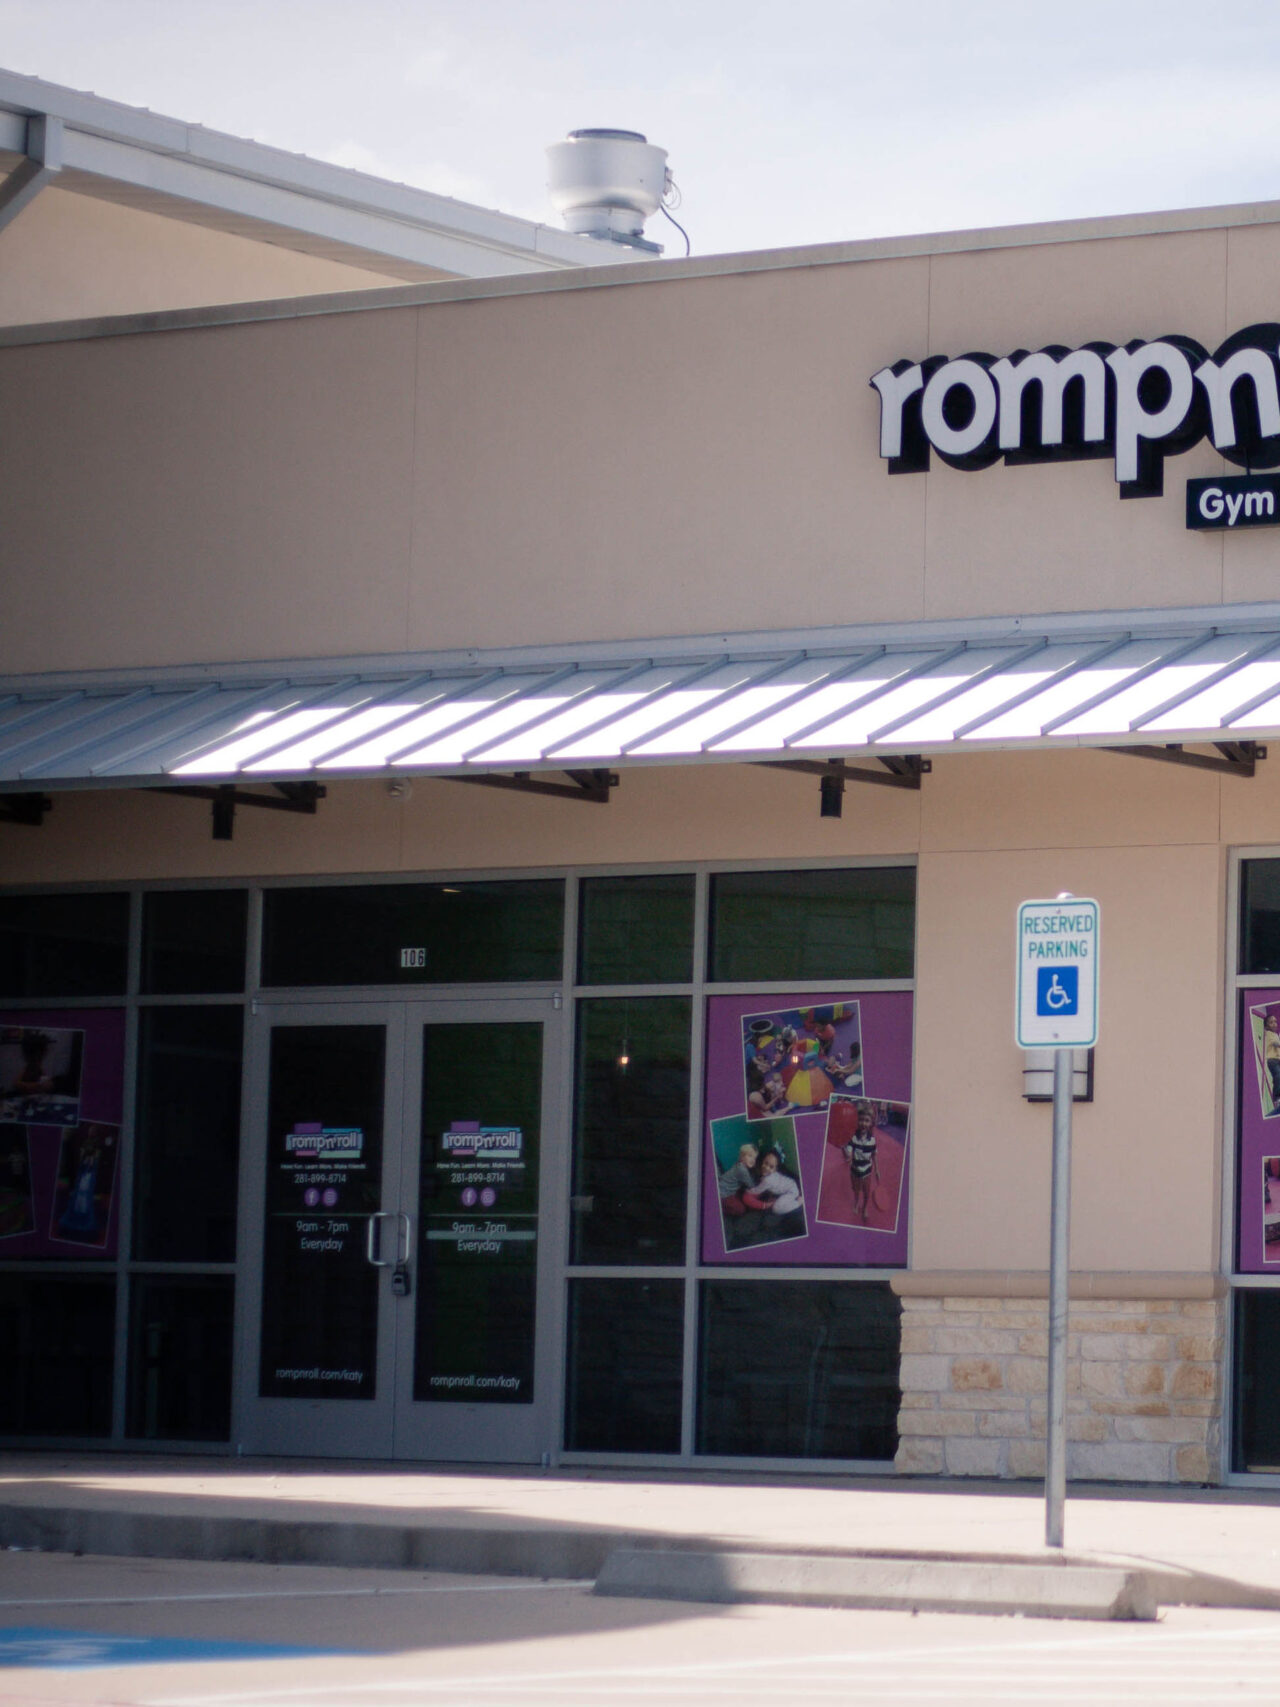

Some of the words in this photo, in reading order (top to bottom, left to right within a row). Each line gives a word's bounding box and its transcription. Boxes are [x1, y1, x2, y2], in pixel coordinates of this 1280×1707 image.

[1199, 487, 1274, 526] Gym
[1024, 914, 1093, 934] RESERVED
[403, 949, 425, 966] 106
[1028, 940, 1088, 959] PARKING
[296, 1220, 318, 1232] 9am
[327, 1221, 349, 1234] 7pm
[301, 1238, 343, 1251] Everyday
[457, 1239, 501, 1253] Everyday
